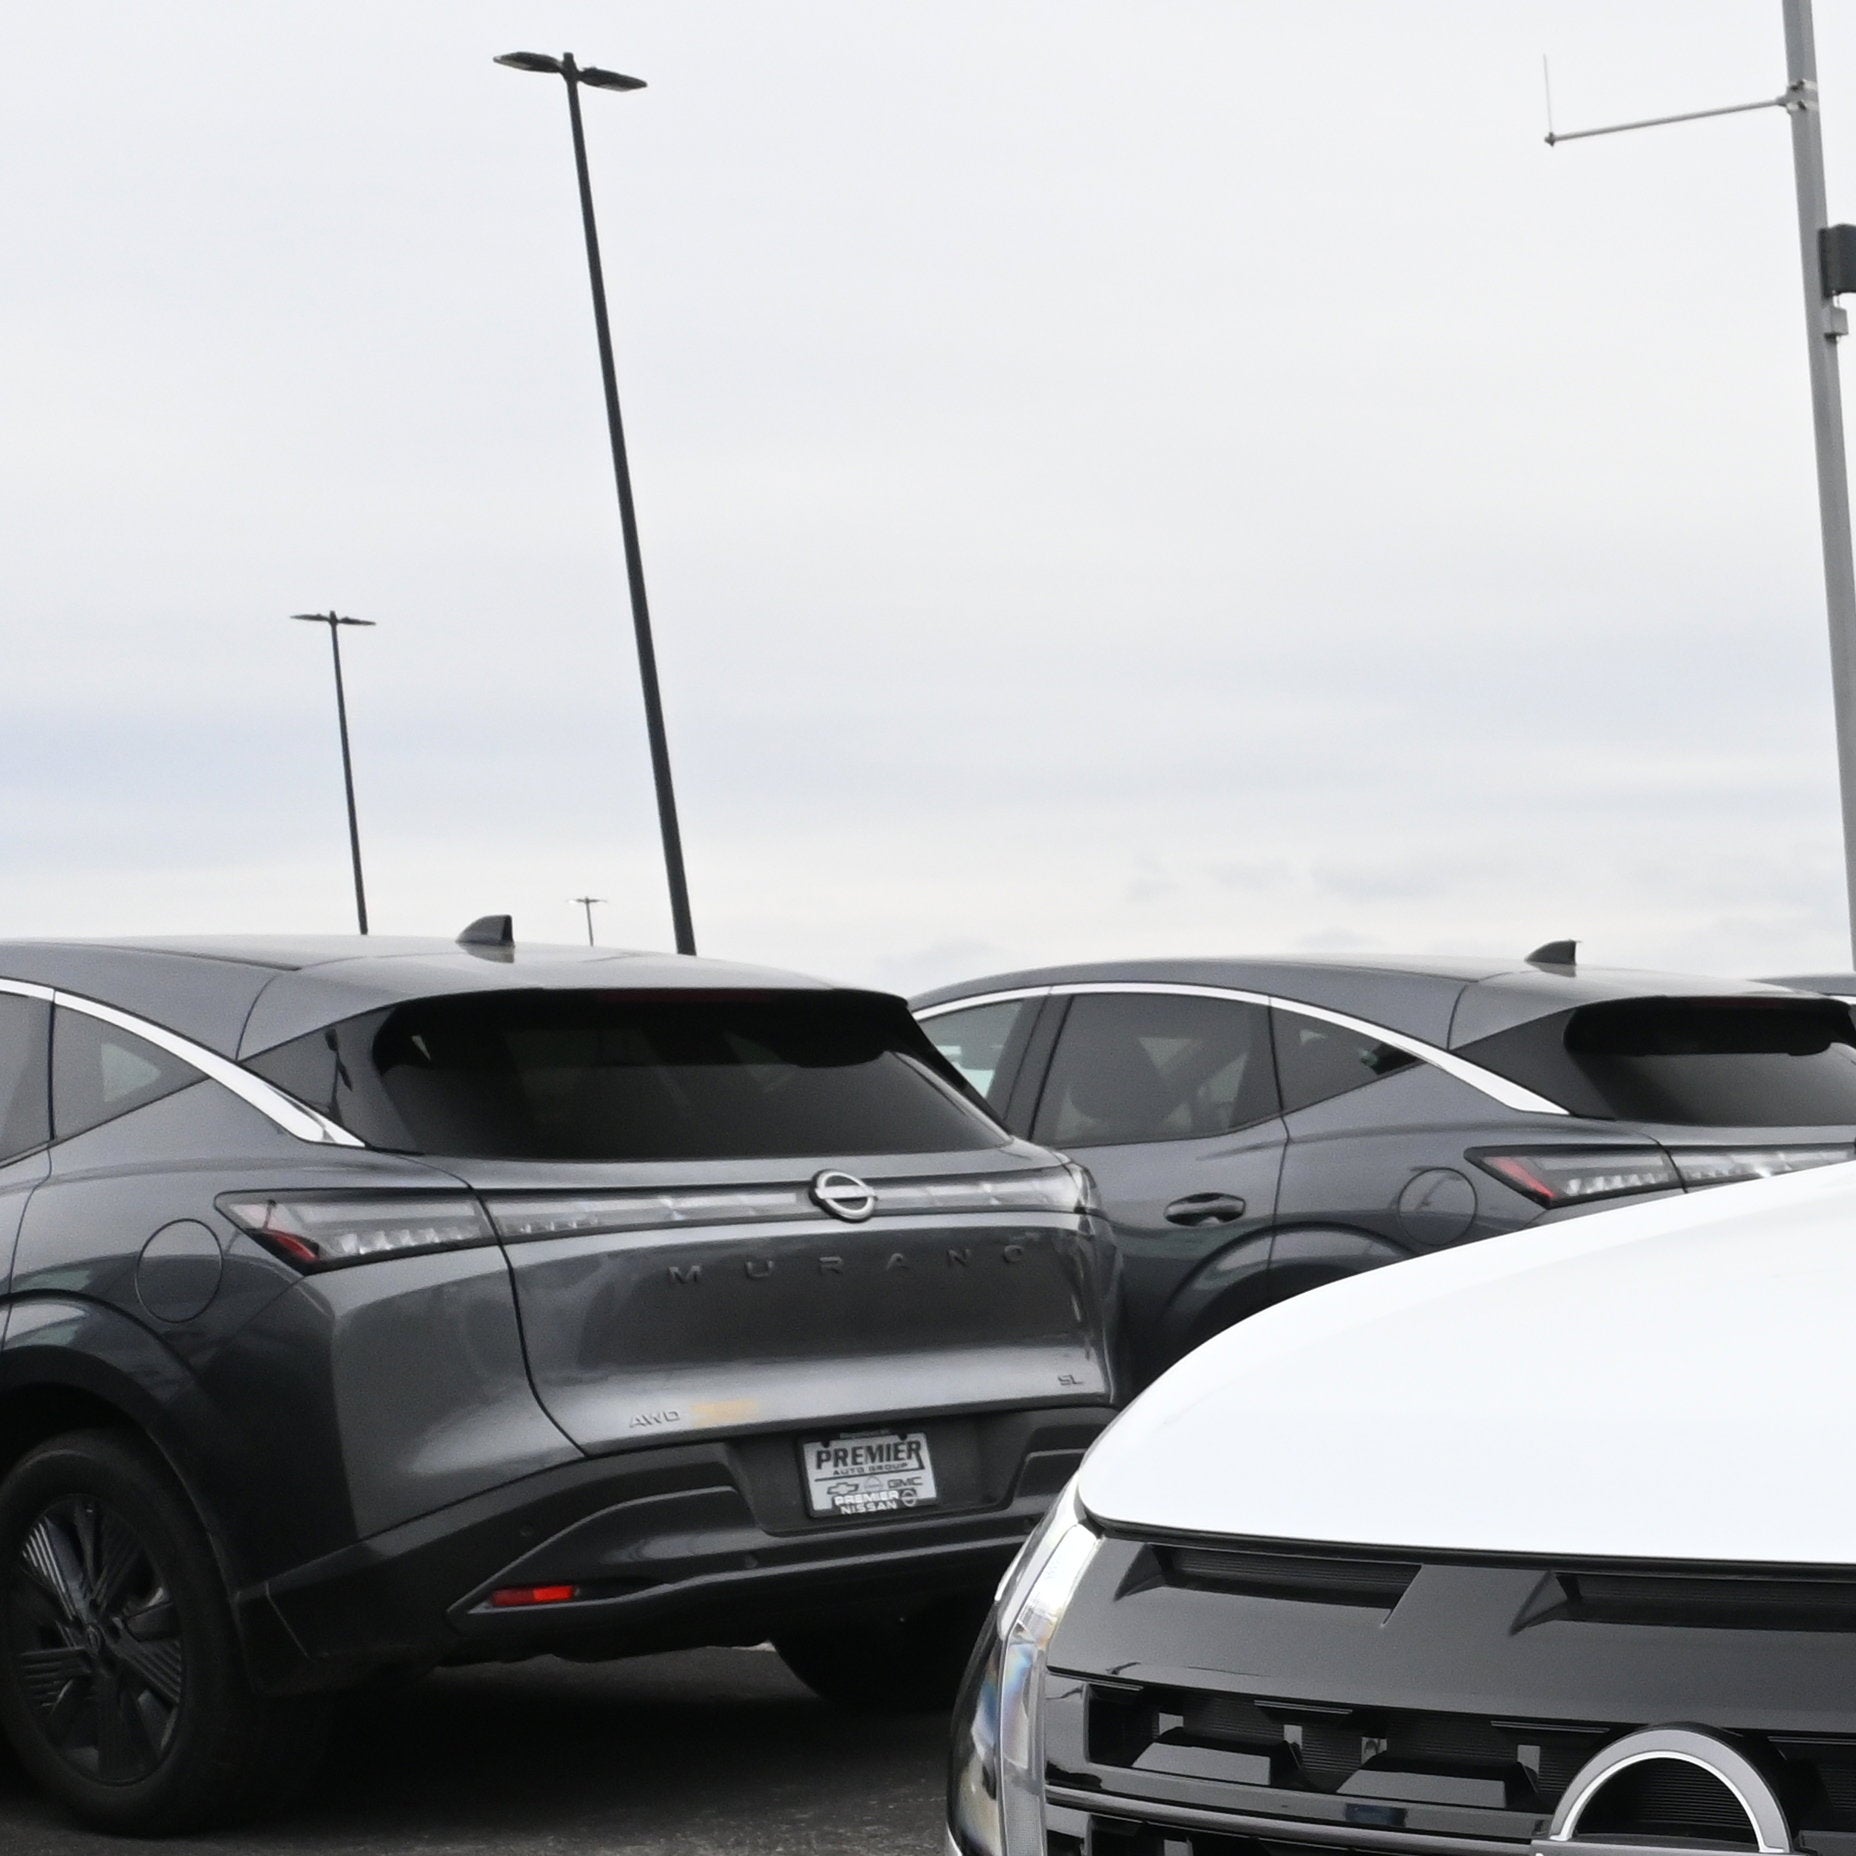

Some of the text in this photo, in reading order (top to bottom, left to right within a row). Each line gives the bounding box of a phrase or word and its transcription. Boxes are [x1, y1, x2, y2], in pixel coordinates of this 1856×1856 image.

[666, 1243, 1026, 1286] MURANO
[1057, 1373, 1085, 1387] SL
[628, 1409, 681, 1429] AWD
[815, 1440, 926, 1471] PREMIER
[832, 1462, 909, 1476] AUTO GROUP
[887, 1476, 924, 1489] GMC
[833, 1490, 900, 1506] PREMIER
[840, 1500, 898, 1515] NISSAN
